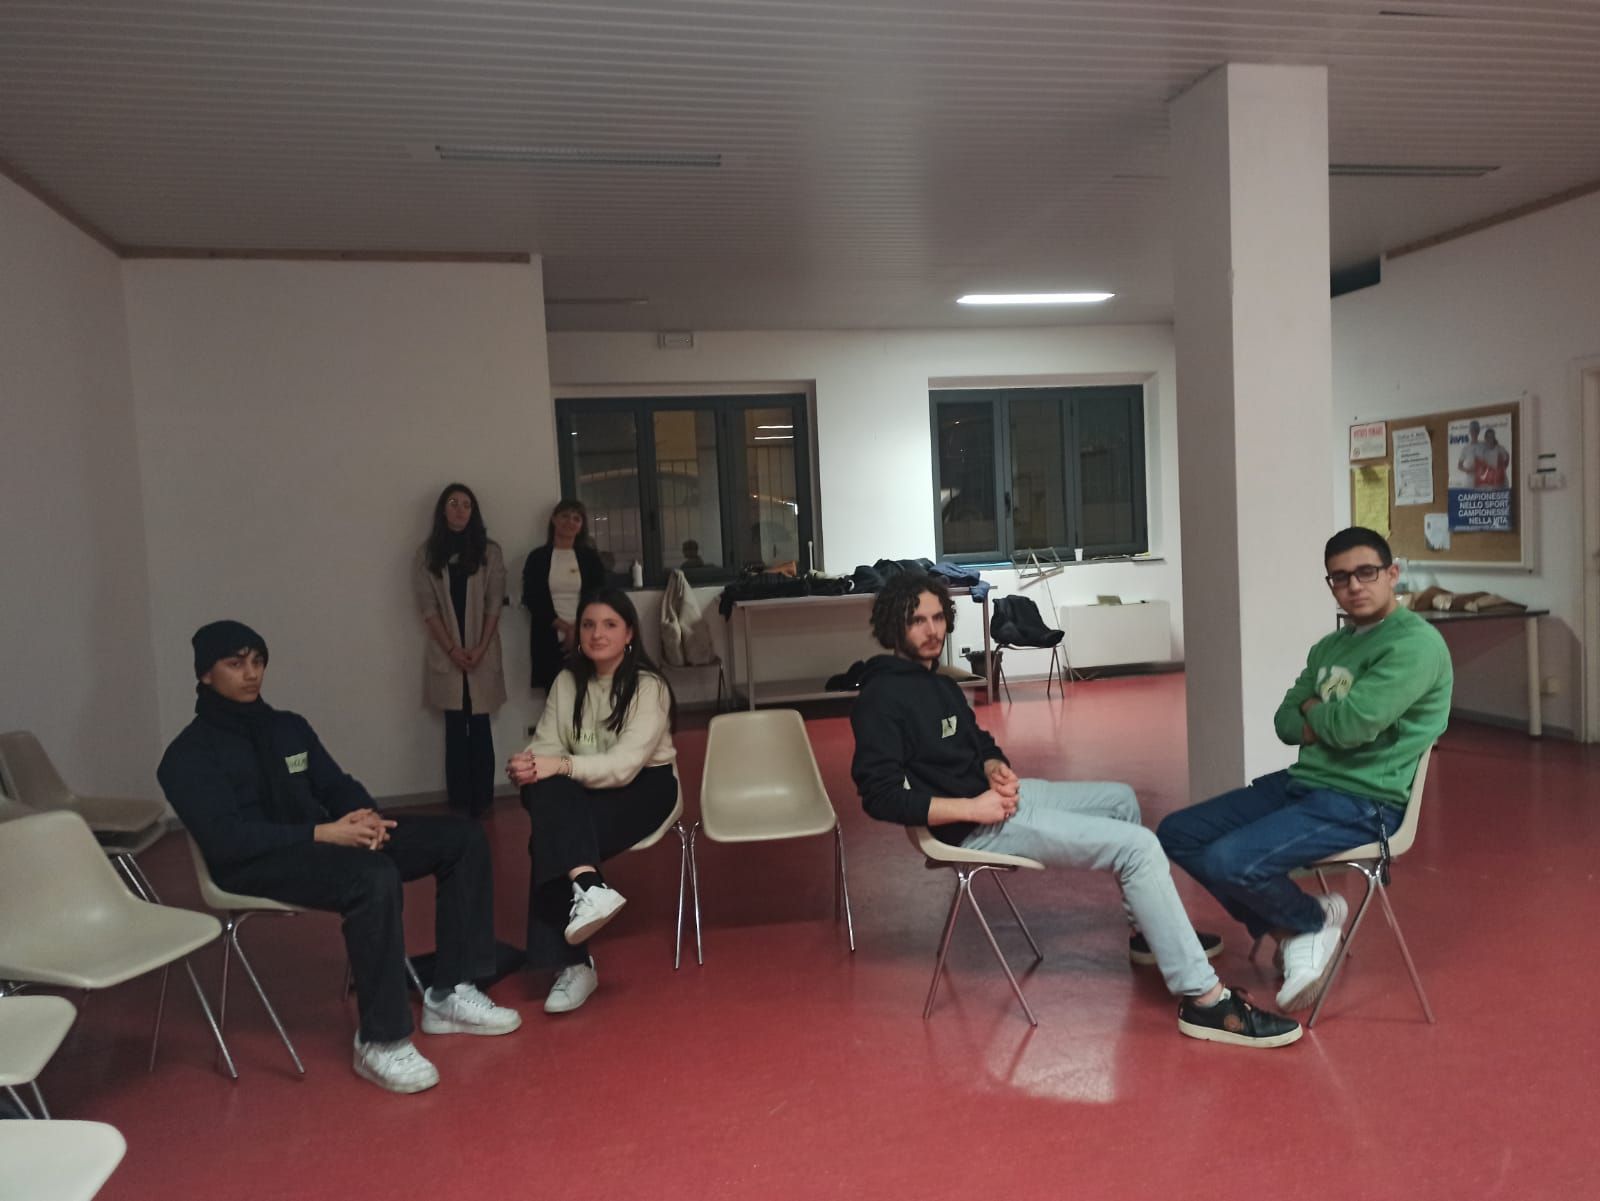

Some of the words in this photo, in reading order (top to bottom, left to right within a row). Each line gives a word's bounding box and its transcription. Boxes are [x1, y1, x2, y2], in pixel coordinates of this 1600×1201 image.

[1457, 491, 1509, 501] CAMPIONESSE
[1459, 500, 1483, 509] NELLO
[1485, 499, 1508, 508] SPORT
[1458, 508, 1509, 517] CAMPIONESSE
[1469, 516, 1491, 525] NELLA
[1493, 516, 1508, 524] VITA
